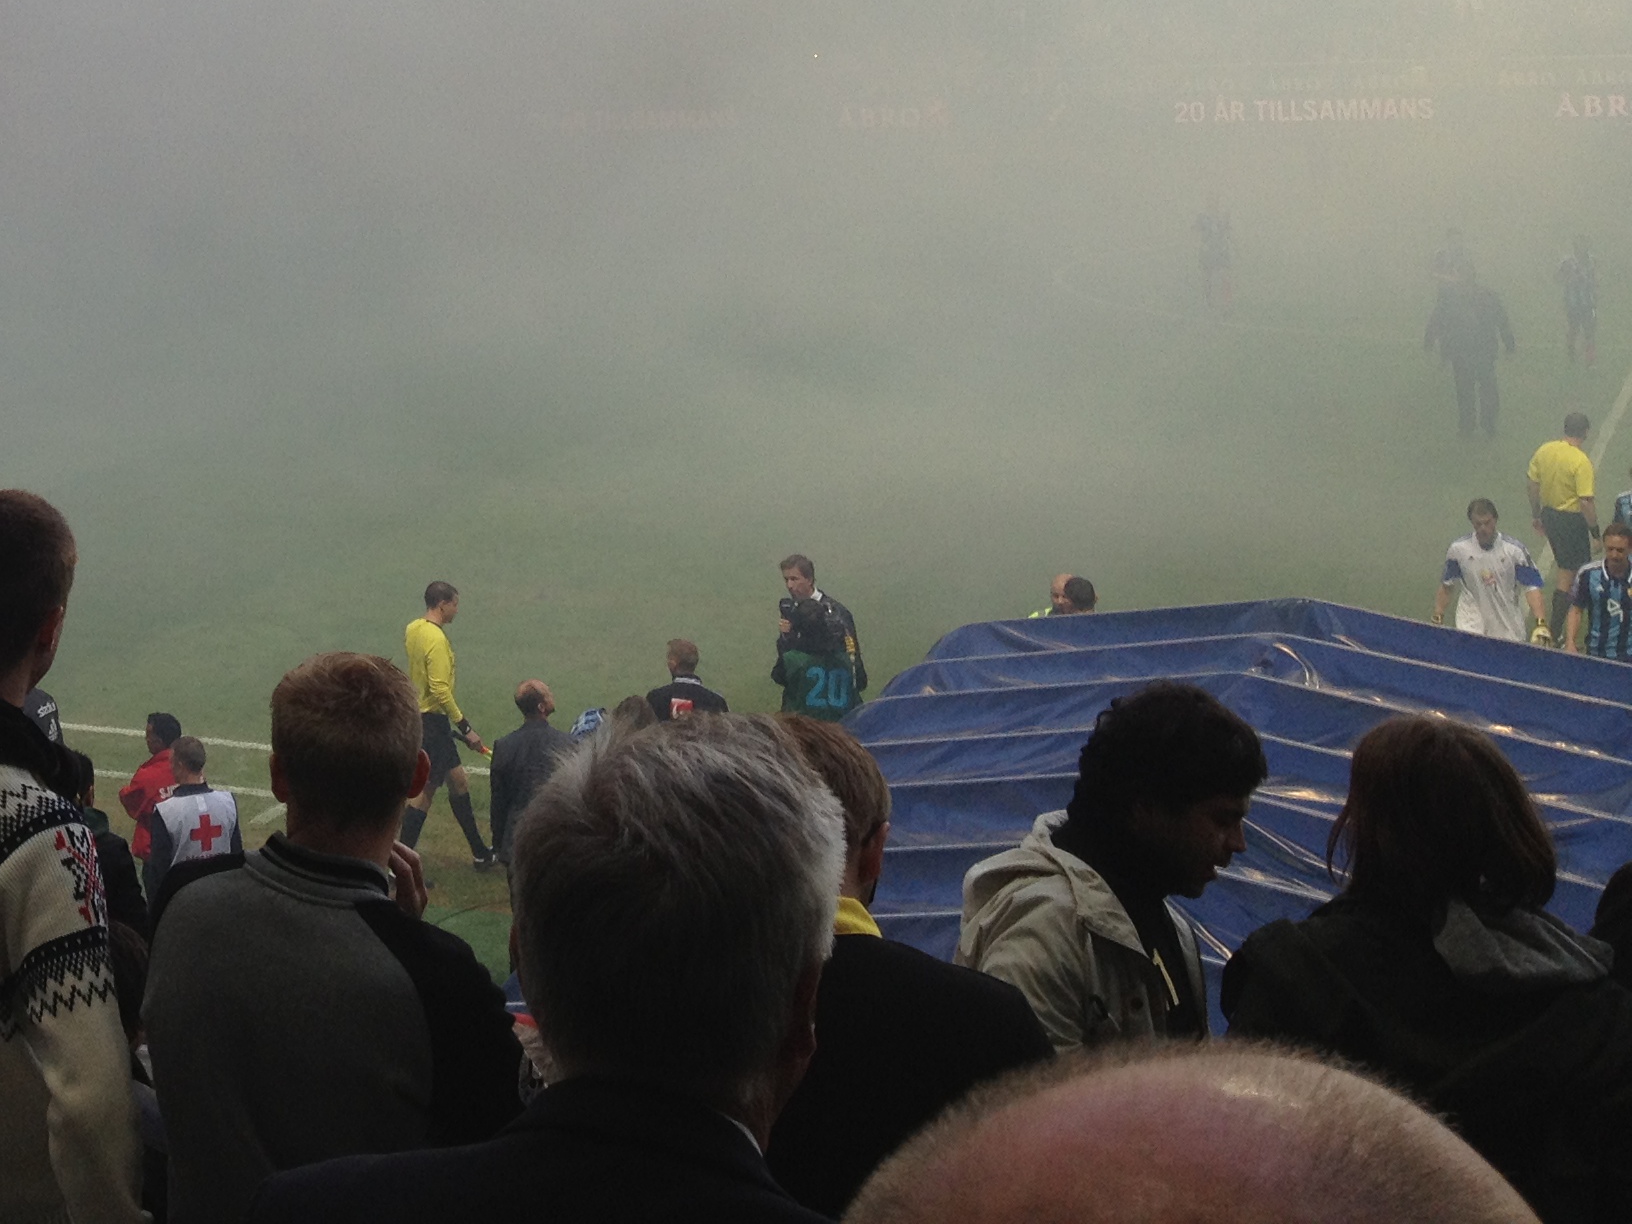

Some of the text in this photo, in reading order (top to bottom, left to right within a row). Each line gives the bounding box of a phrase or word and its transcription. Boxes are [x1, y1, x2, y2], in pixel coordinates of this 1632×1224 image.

[1174, 100, 1205, 123] 20
[1254, 97, 1434, 122] TILLSAMMANS
[805, 666, 848, 707] 20
